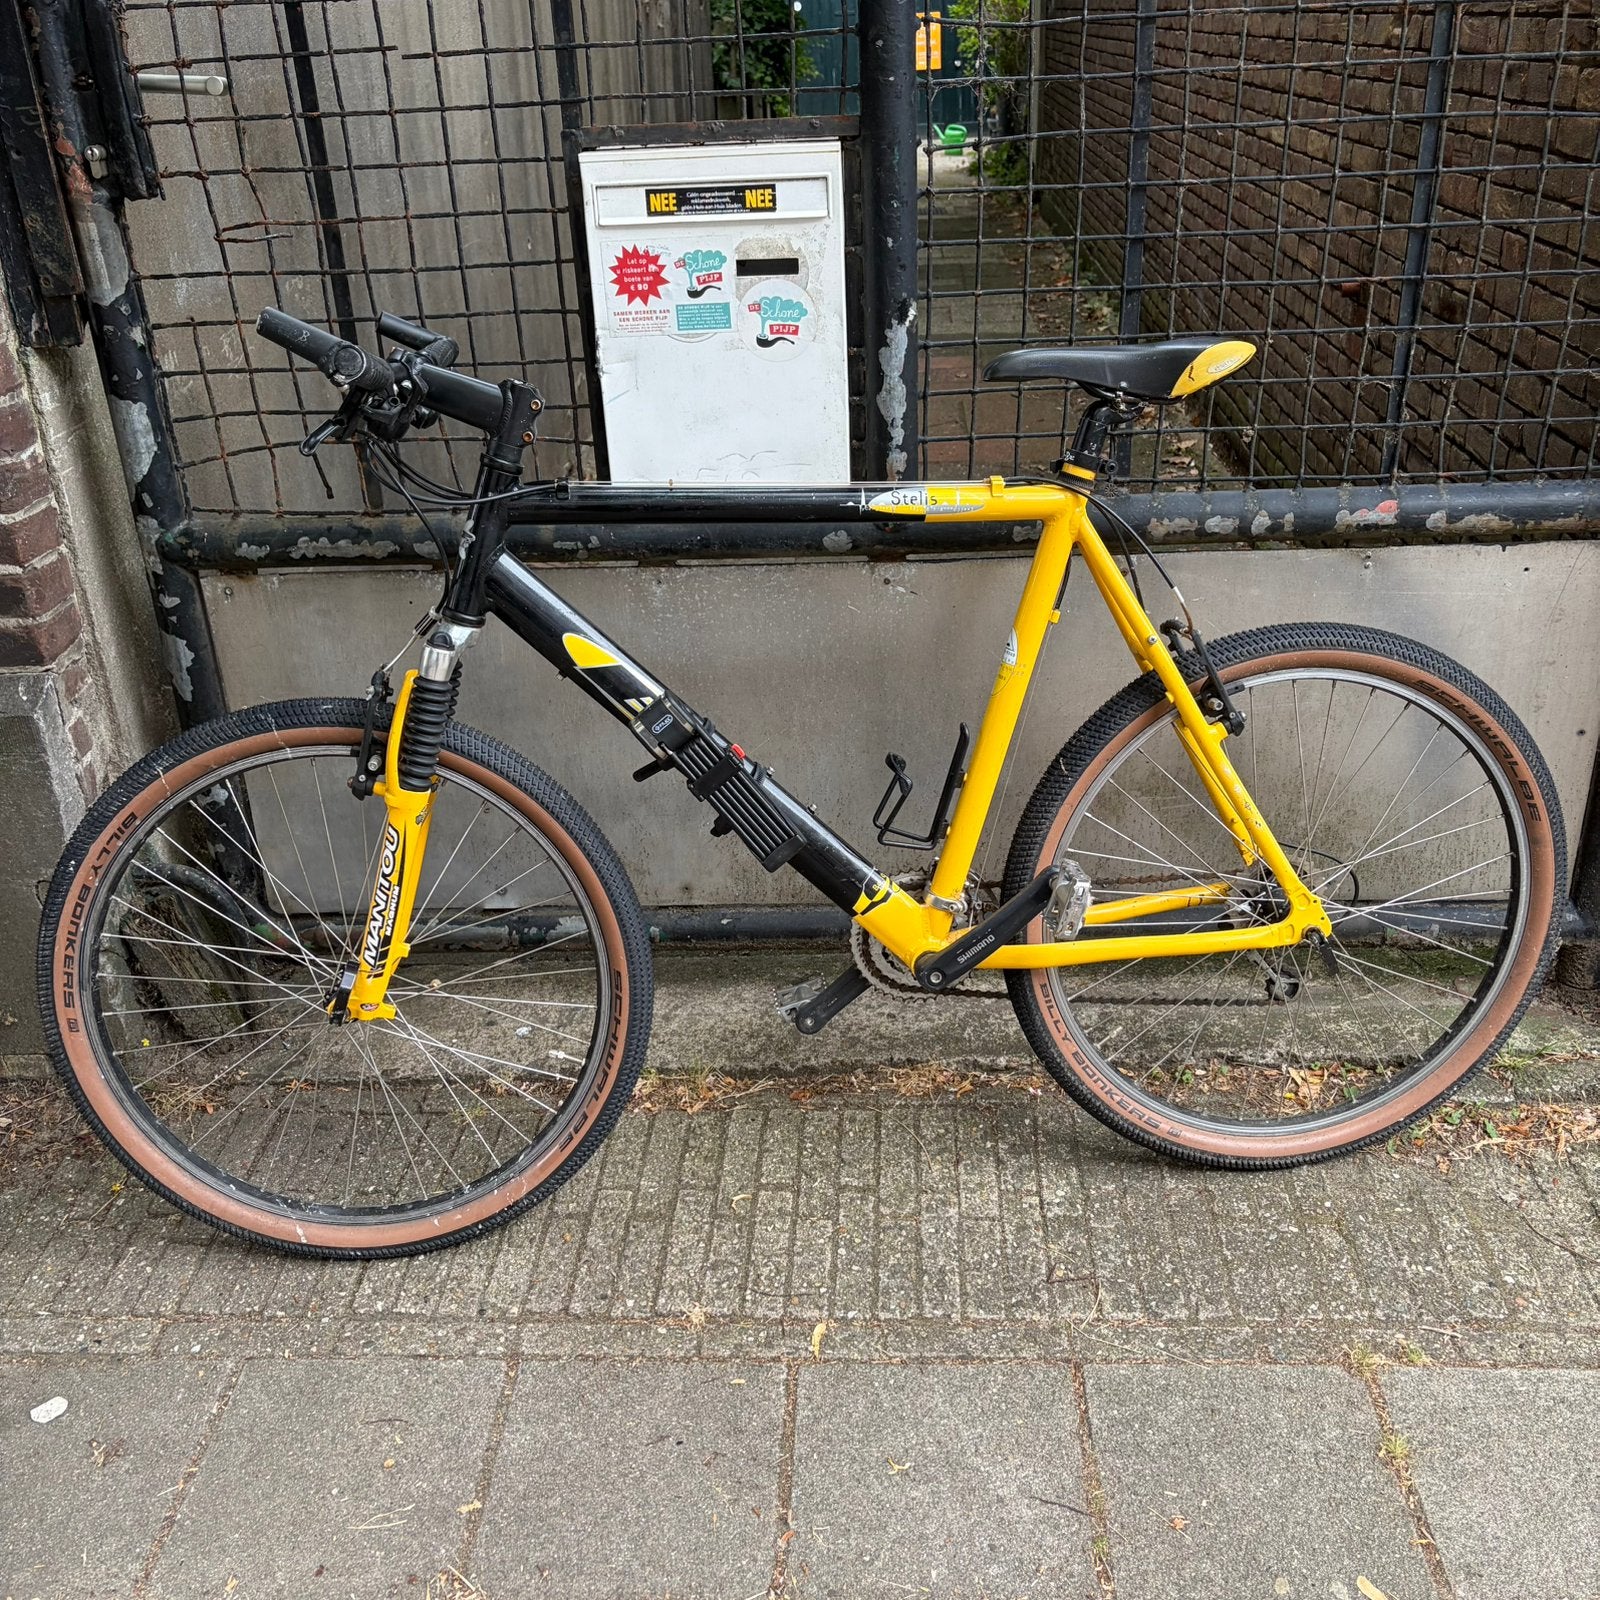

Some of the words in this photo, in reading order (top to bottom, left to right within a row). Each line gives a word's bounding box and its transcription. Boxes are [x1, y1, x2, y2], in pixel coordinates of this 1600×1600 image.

[649, 192, 678, 212] NEE
[745, 188, 774, 209] NEE
[622, 266, 647, 274] riskeert
[684, 251, 721, 271] Schone
[637, 283, 649, 291] 90
[699, 273, 720, 284] PIJP
[761, 299, 801, 318] Schone
[772, 325, 796, 333] PIJP
[890, 490, 938, 506] Stelis
[1415, 679, 1542, 823] SCHWALBE
[90, 810, 138, 879] BILLY
[362, 822, 400, 968] MANITOU
[384, 884, 400, 938] MAGNUM
[62, 883, 92, 1009] BONKERS
[956, 933, 996, 965] SHIMANO
[559, 970, 623, 1154] SCHWALBE
[1039, 983, 1073, 1044] BILLY
[1071, 1050, 1162, 1130] BONKERS
